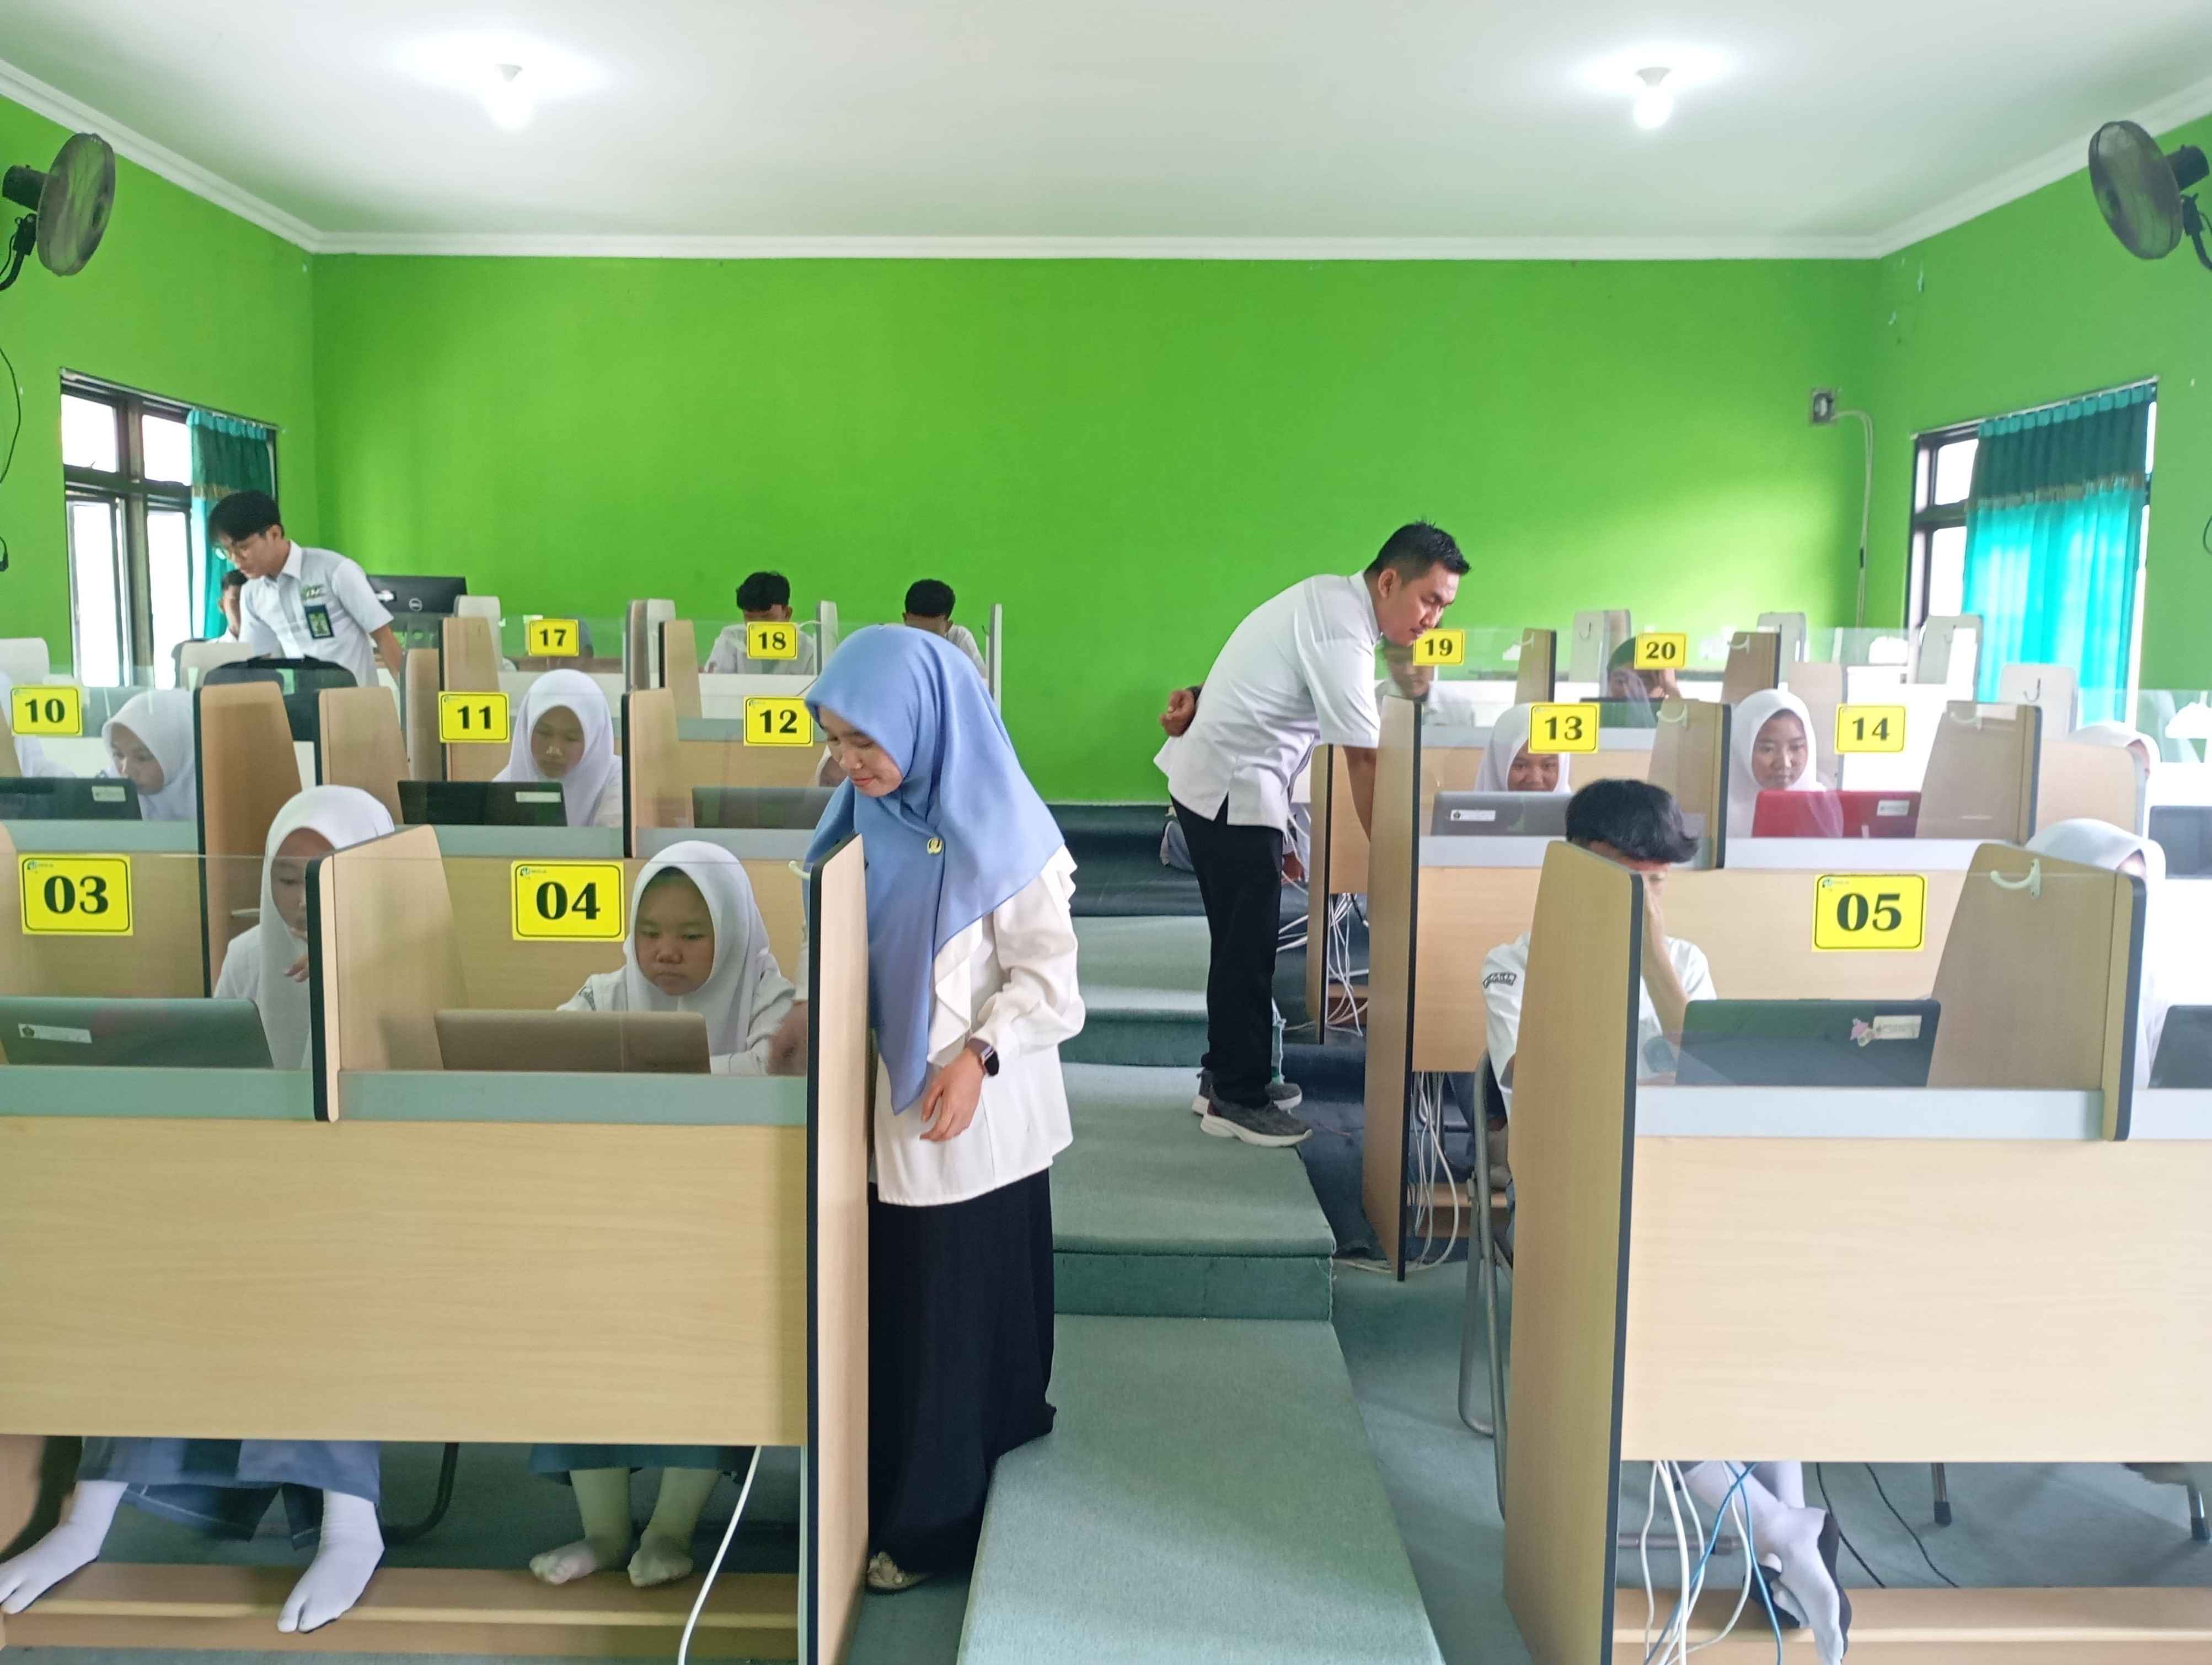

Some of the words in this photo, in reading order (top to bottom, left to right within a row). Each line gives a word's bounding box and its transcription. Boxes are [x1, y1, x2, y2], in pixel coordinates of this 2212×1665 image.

[539, 629, 566, 647] 17
[758, 632, 786, 651] 18
[1424, 638, 1453, 656] 19
[1646, 641, 1676, 660] 20
[25, 699, 65, 723] 10
[457, 705, 491, 729] 11
[759, 710, 797, 734] 12
[1545, 716, 1582, 740] 13
[1852, 717, 1889, 741] 14
[44, 876, 109, 915] 03
[536, 882, 601, 920] 04
[1836, 893, 1902, 931] 05
